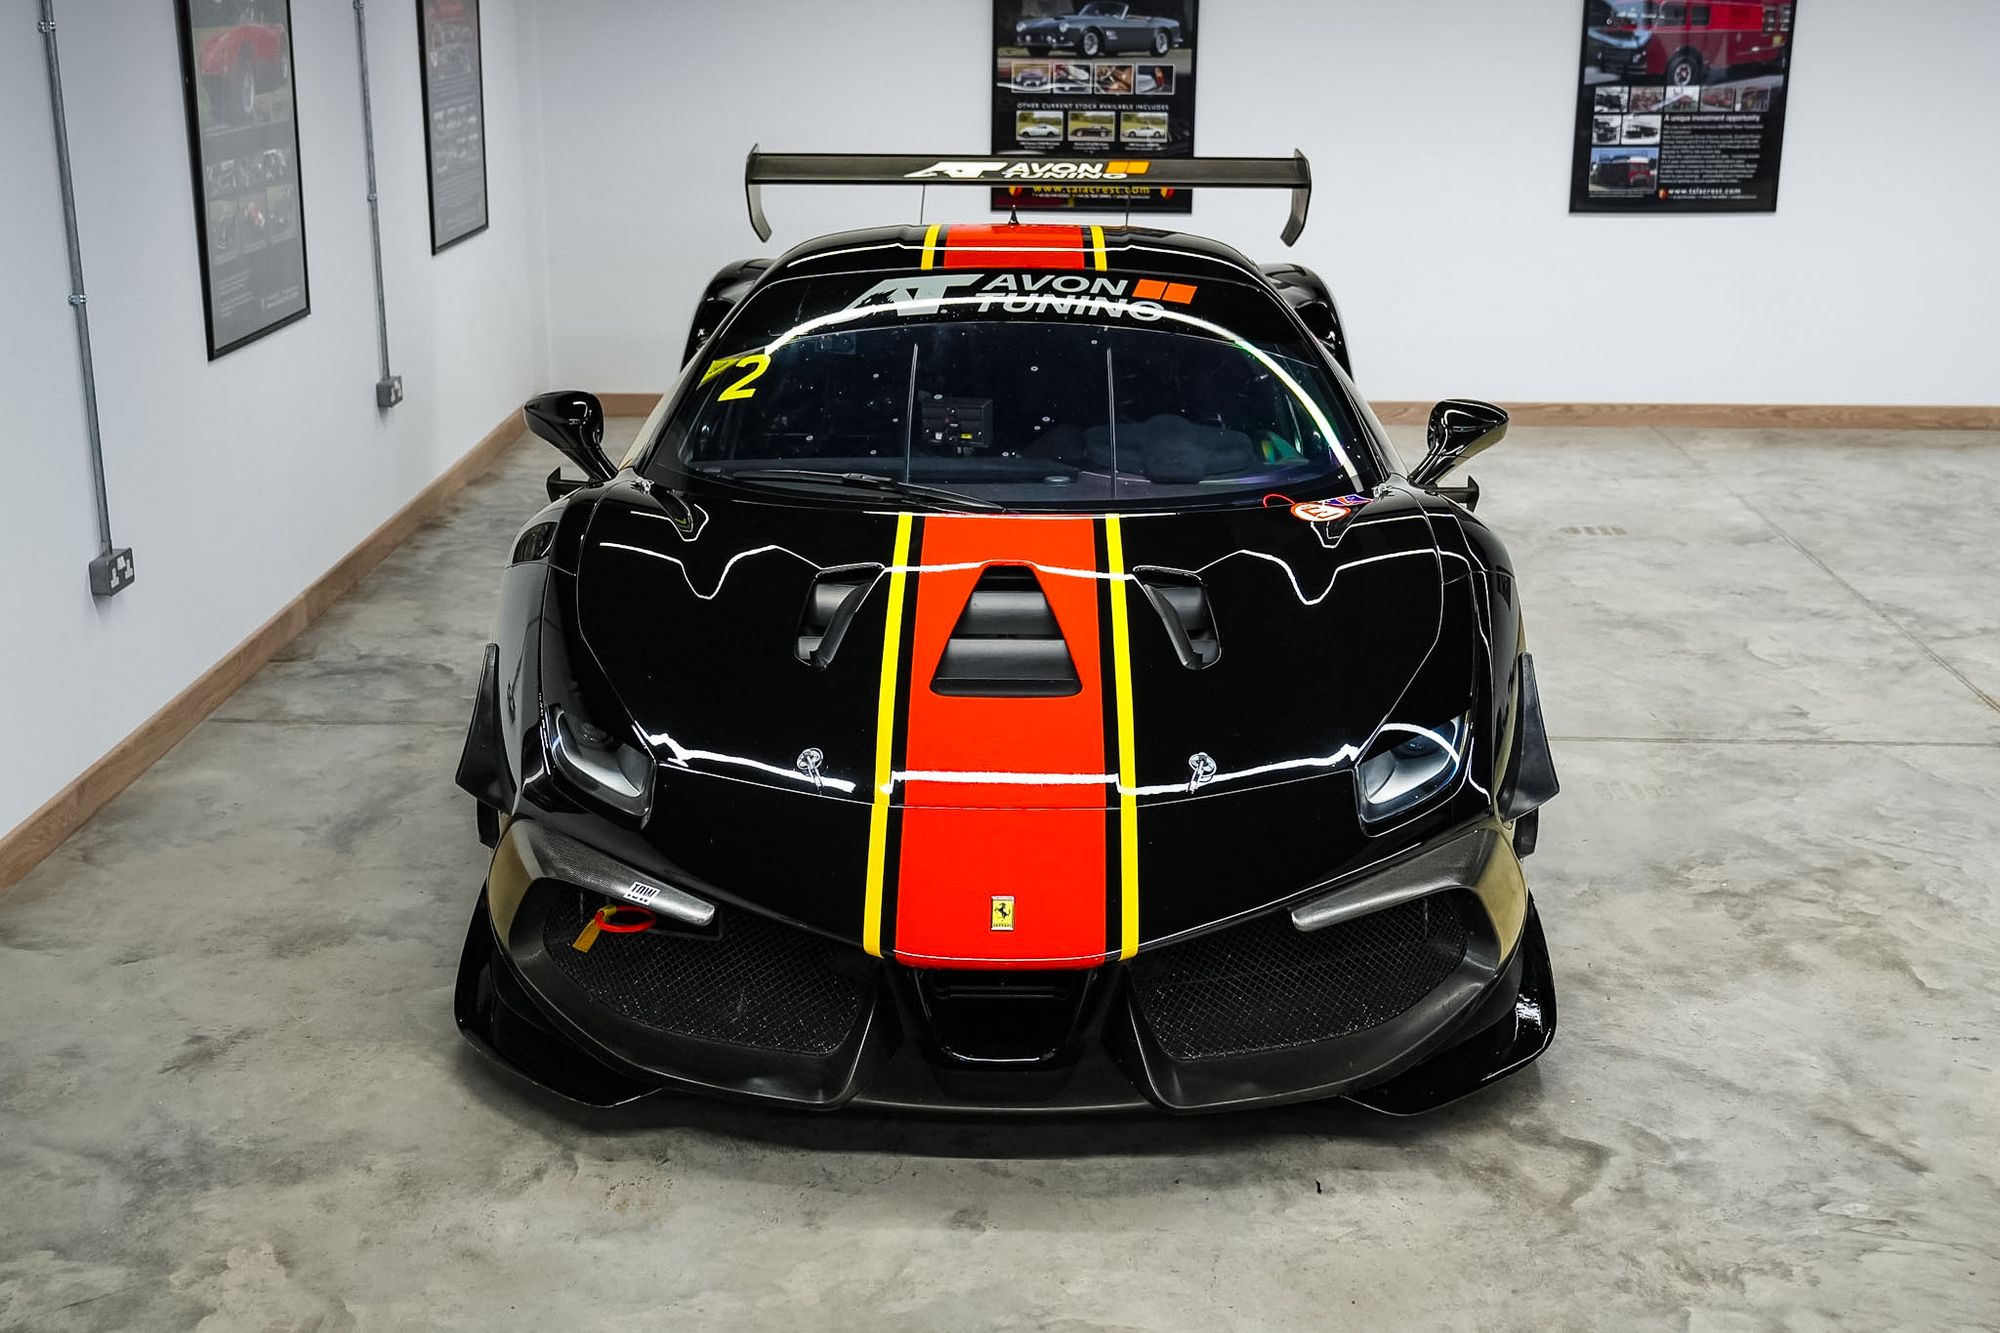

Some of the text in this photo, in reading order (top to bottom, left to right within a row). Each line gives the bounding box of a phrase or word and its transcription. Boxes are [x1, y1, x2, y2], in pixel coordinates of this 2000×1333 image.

[1725, 114, 1760, 123] opportunity
[1001, 162, 1105, 174] AVON
[1002, 172, 1128, 180] TUNING
[981, 273, 1129, 296] AVON
[973, 292, 1165, 322] TUNING
[717, 354, 771, 402] 2
